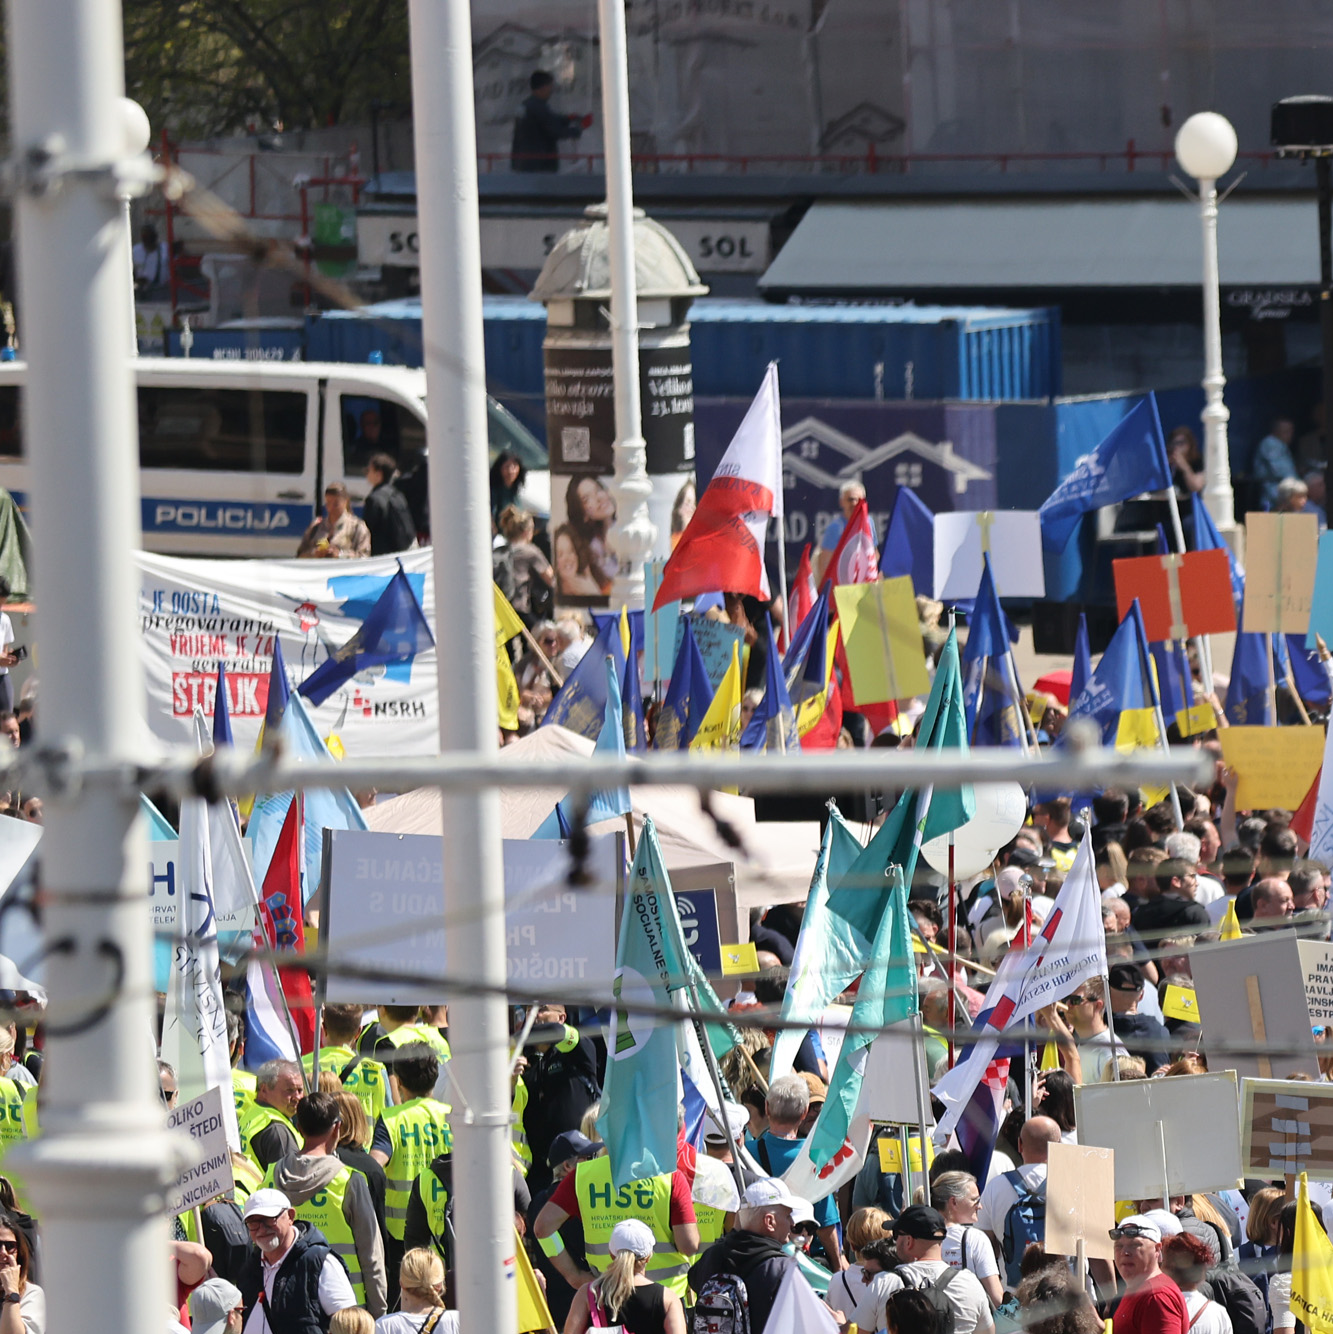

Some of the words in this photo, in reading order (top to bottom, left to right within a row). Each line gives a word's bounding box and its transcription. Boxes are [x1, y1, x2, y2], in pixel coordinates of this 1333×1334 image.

[699, 235, 753, 258] SOL
[155, 506, 290, 529] POLICIJA
[151, 592, 166, 613] JE
[171, 592, 220, 615] DOSTA
[170, 634, 228, 656] VRIJEME
[235, 636, 248, 656] JE
[254, 636, 273, 656] ZA
[374, 700, 426, 717] NSRH
[1325, 952, 1329, 962] I
[188, 1111, 223, 1140] ŠTEDI
[588, 1182, 655, 1210] HSt
[590, 1214, 623, 1222] HRVATSKI
[1289, 1289, 1319, 1316] MATICA
